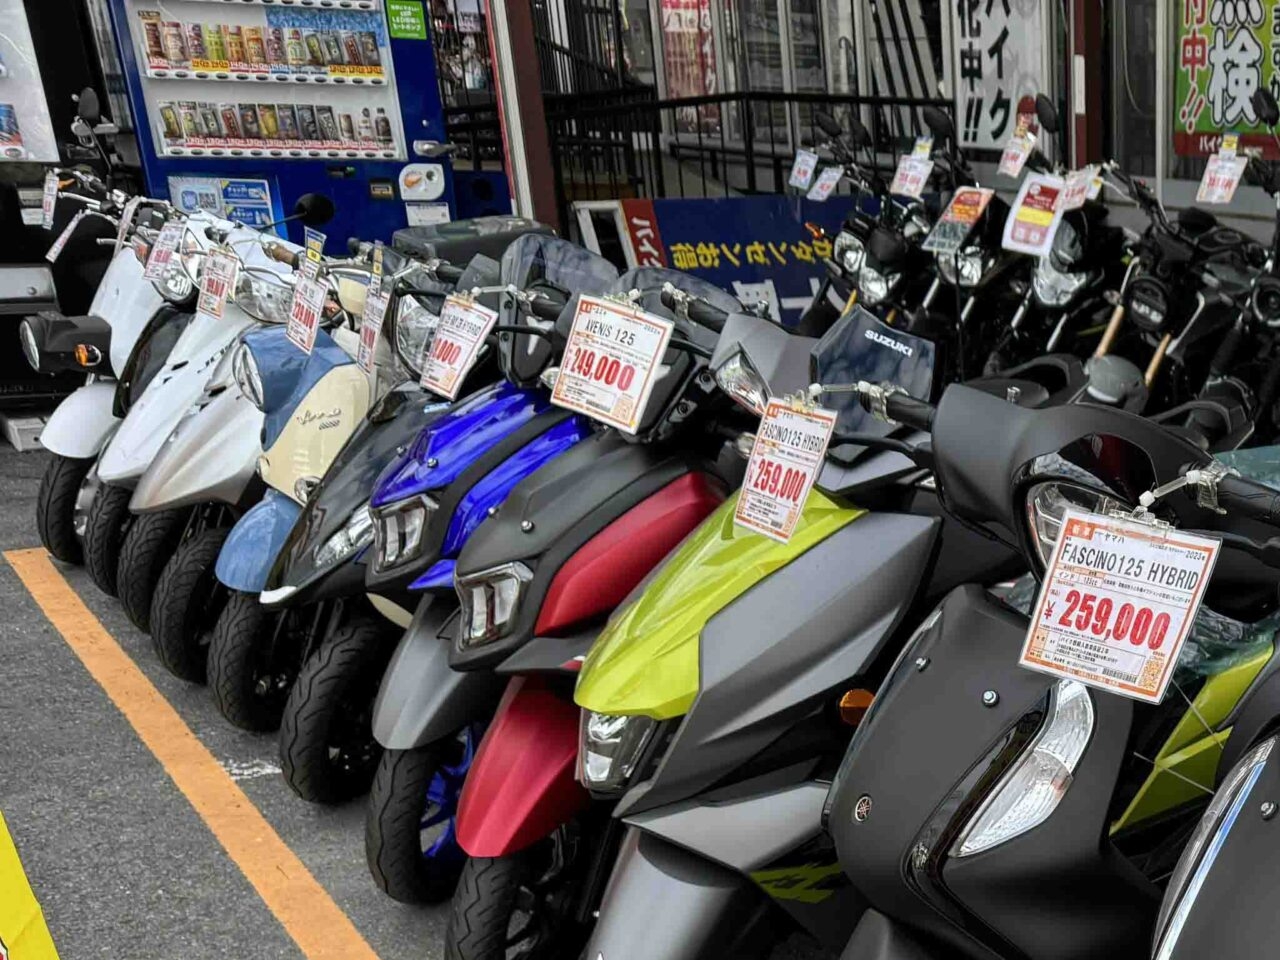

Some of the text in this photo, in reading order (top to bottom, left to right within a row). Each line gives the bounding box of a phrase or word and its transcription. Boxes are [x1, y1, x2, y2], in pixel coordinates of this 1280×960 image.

[585, 319, 636, 346] AVENIS 125
[864, 329, 914, 358] SUZUKI
[570, 347, 636, 392] 249,000
[762, 422, 825, 453] FASCINO125 HYBRID
[753, 458, 807, 503] 259,000
[1061, 542, 1145, 578] FASCINO125
[1147, 562, 1200, 591] HYBRID
[1058, 589, 1171, 651] 259,000
